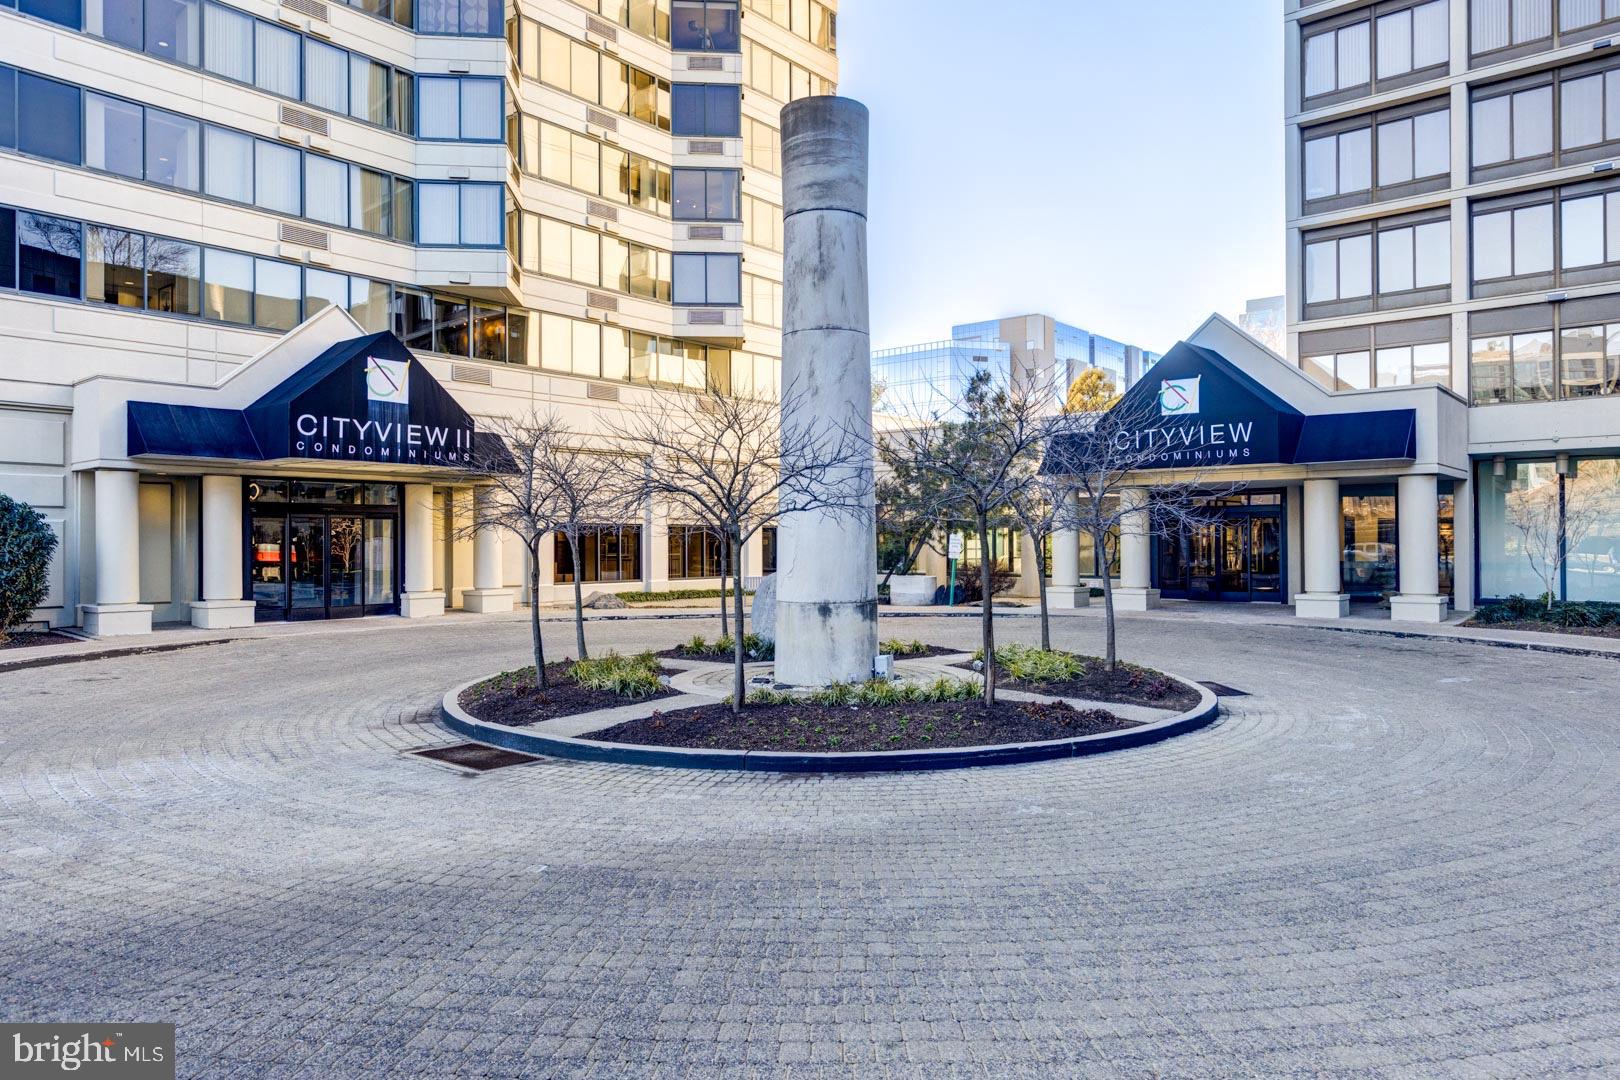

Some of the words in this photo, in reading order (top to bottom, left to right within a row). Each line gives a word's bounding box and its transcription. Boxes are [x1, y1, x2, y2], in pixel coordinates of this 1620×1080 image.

[296, 413, 449, 447] CITYVIEW
[456, 428, 470, 448] II
[1114, 421, 1253, 450] CITYVIEW
[296, 441, 470, 461] CONDOMINIUMS
[1114, 447, 1251, 463] CONDOMINIUMS
